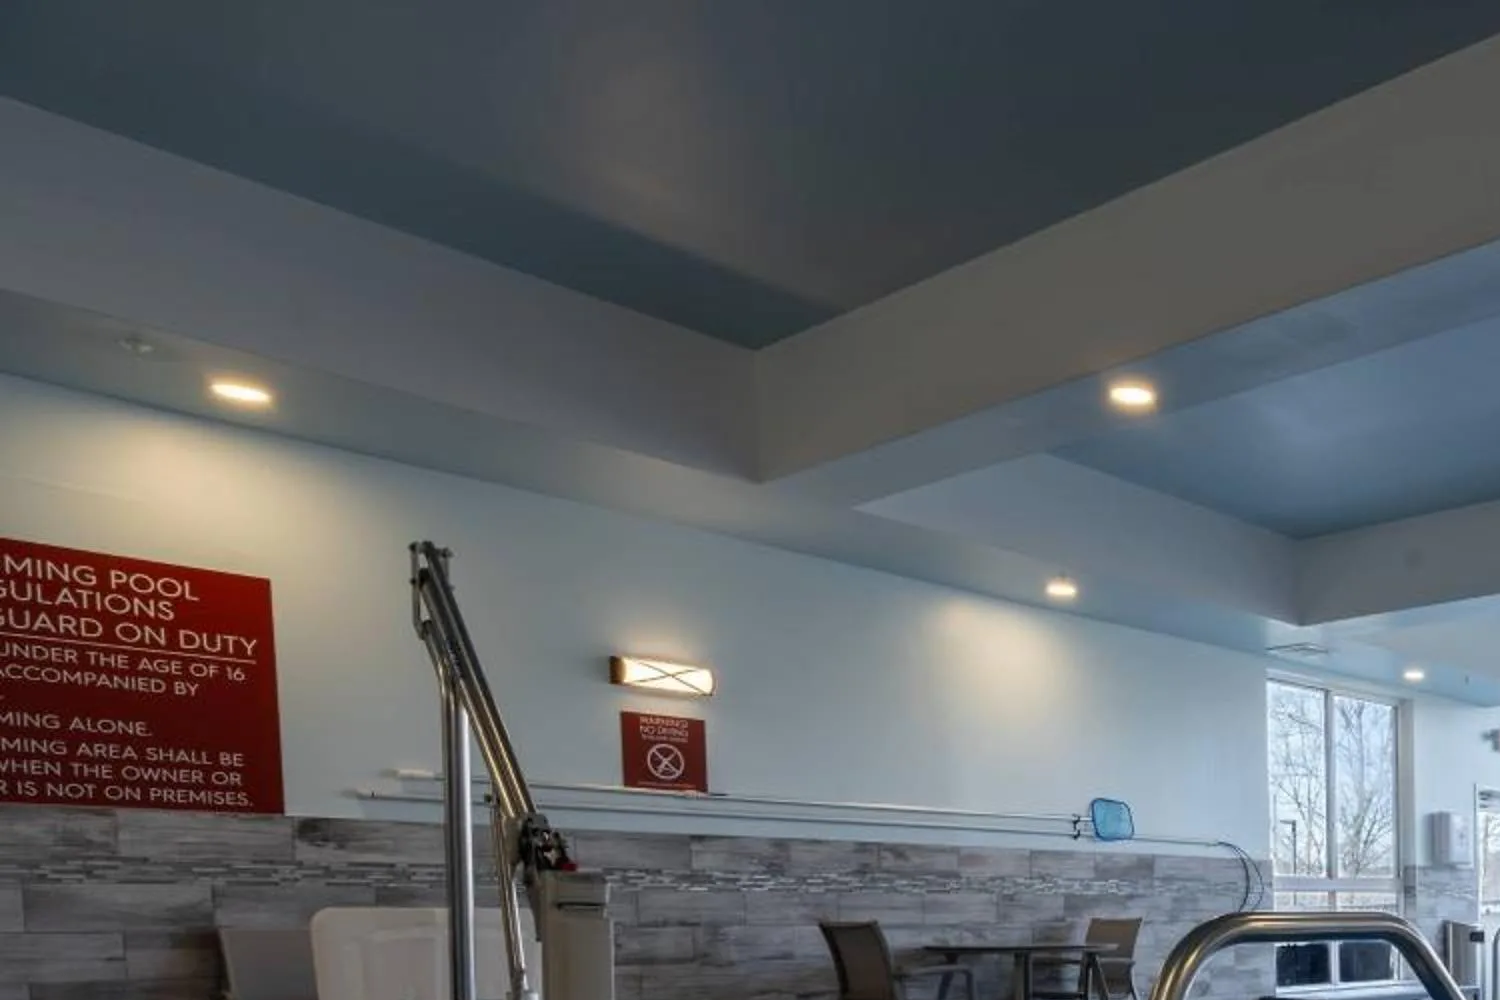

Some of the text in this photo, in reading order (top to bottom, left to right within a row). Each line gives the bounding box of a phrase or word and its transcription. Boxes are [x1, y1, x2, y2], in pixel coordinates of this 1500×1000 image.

[109, 568, 200, 602] POOL
[0, 606, 257, 657] UARD ON DUTY
[85, 650, 129, 670] THE
[137, 656, 183, 676] AGE
[189, 662, 220, 679] OF
[173, 680, 200, 698] BY
[76, 742, 138, 761] AREA
[145, 746, 213, 766] SHALL
[218, 751, 245, 768] BE
[70, 761, 113, 780] THE
[121, 765, 205, 784] OWNER
[211, 770, 243, 787] OR
[16, 780, 39, 798] IS
[46, 782, 98, 800] NOT
[104, 785, 142, 802] ON
